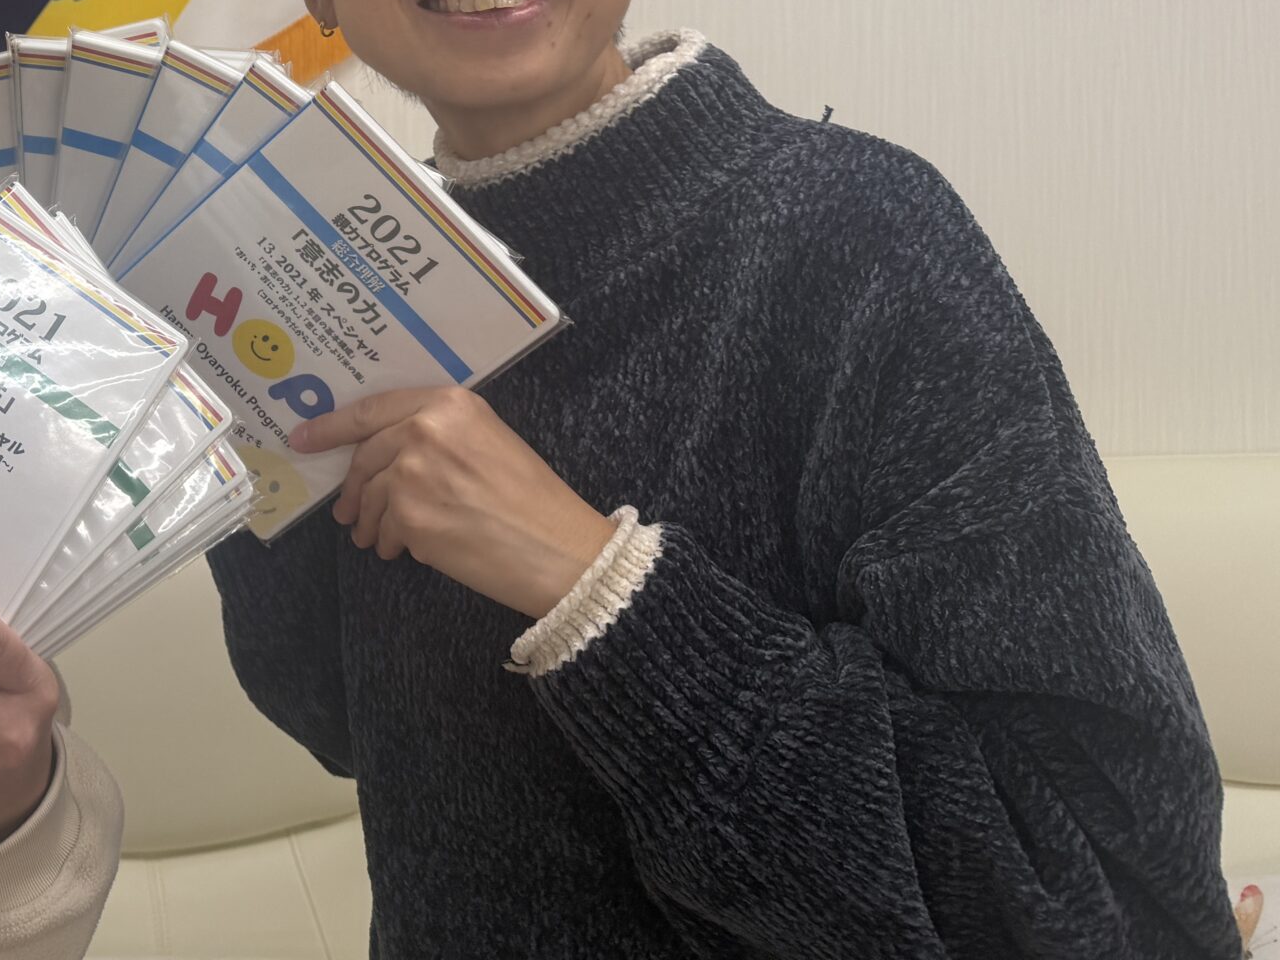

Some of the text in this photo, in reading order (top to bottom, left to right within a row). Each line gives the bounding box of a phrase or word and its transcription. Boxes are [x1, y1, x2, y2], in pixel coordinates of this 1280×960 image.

[291, 228, 388, 336] 「意志の力」
[330, 239, 386, 294] 総合理解
[331, 213, 410, 296] 親力プログラム
[347, 193, 439, 284] 2021
[275, 256, 308, 290] 2021
[320, 302, 381, 362] スペシャル
[196, 342, 250, 399] Oyaryoku
